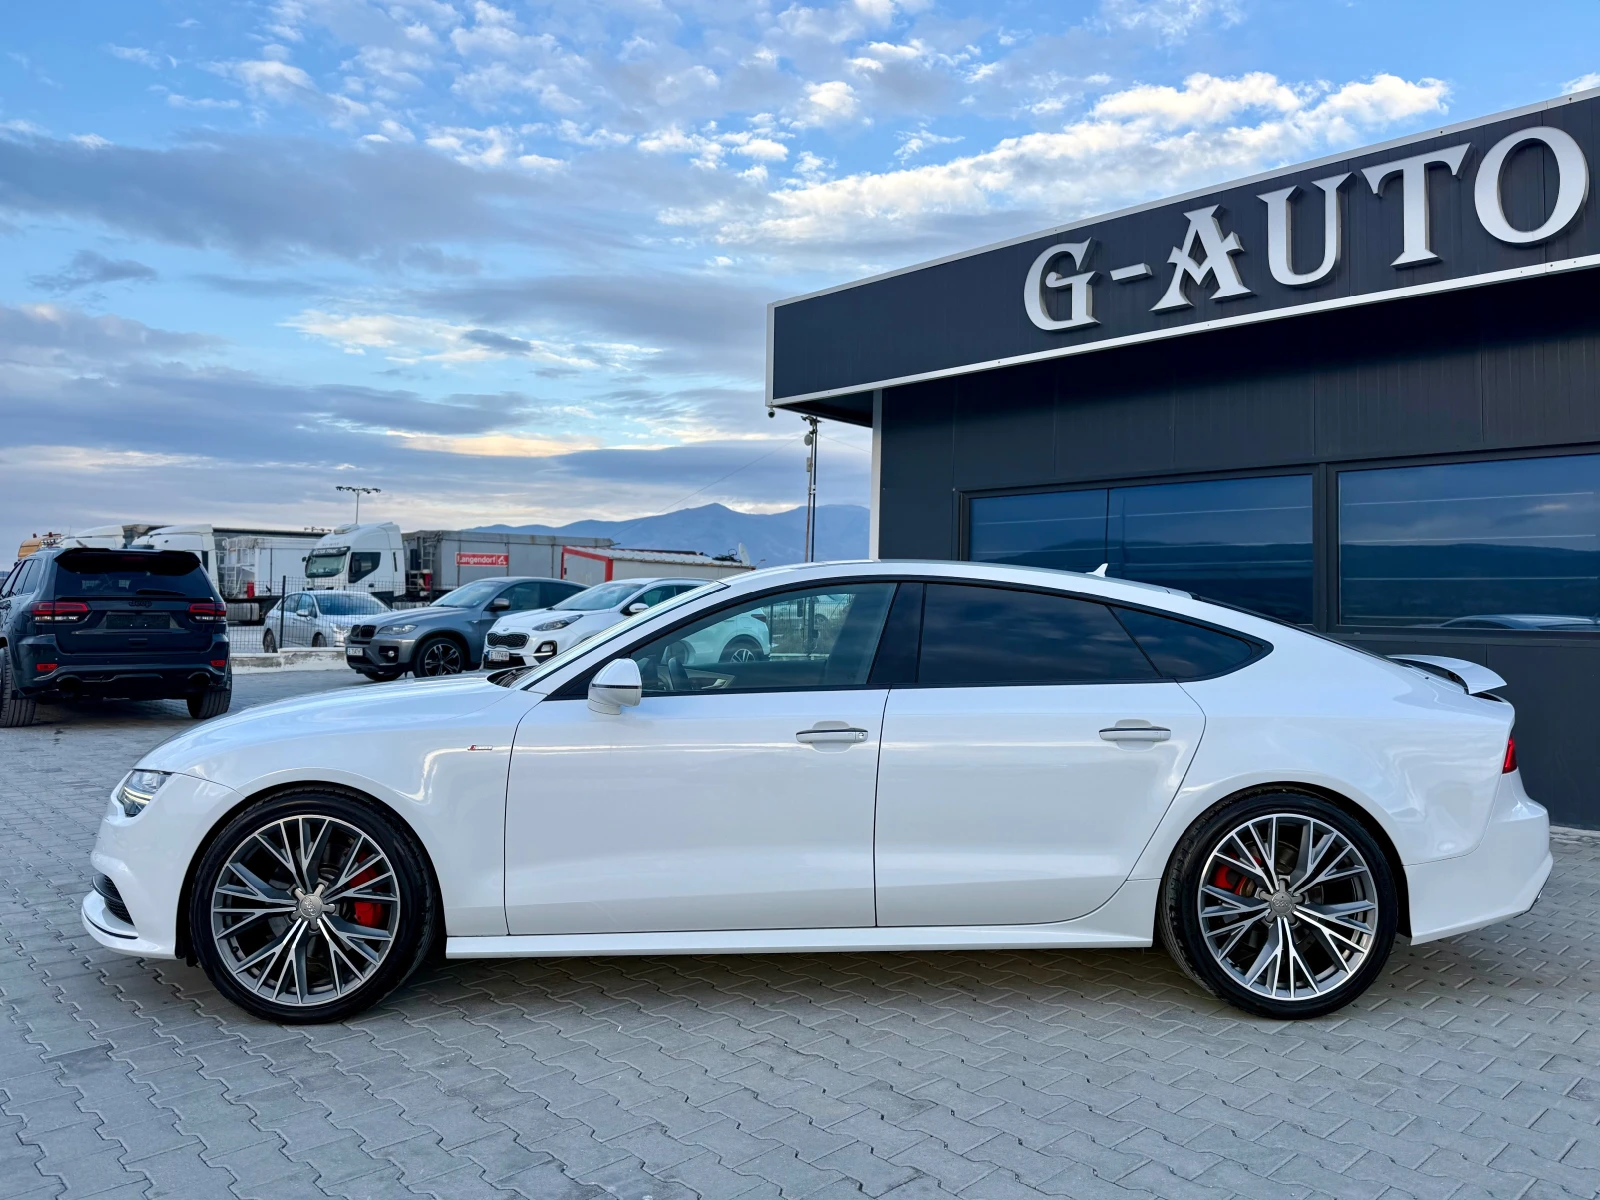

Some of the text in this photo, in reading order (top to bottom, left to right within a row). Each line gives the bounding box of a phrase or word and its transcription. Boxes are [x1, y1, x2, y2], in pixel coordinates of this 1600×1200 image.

[1023, 125, 1590, 332] G-AUTO
[457, 554, 496, 564] Langendorf
[128, 600, 153, 609] Jeep
